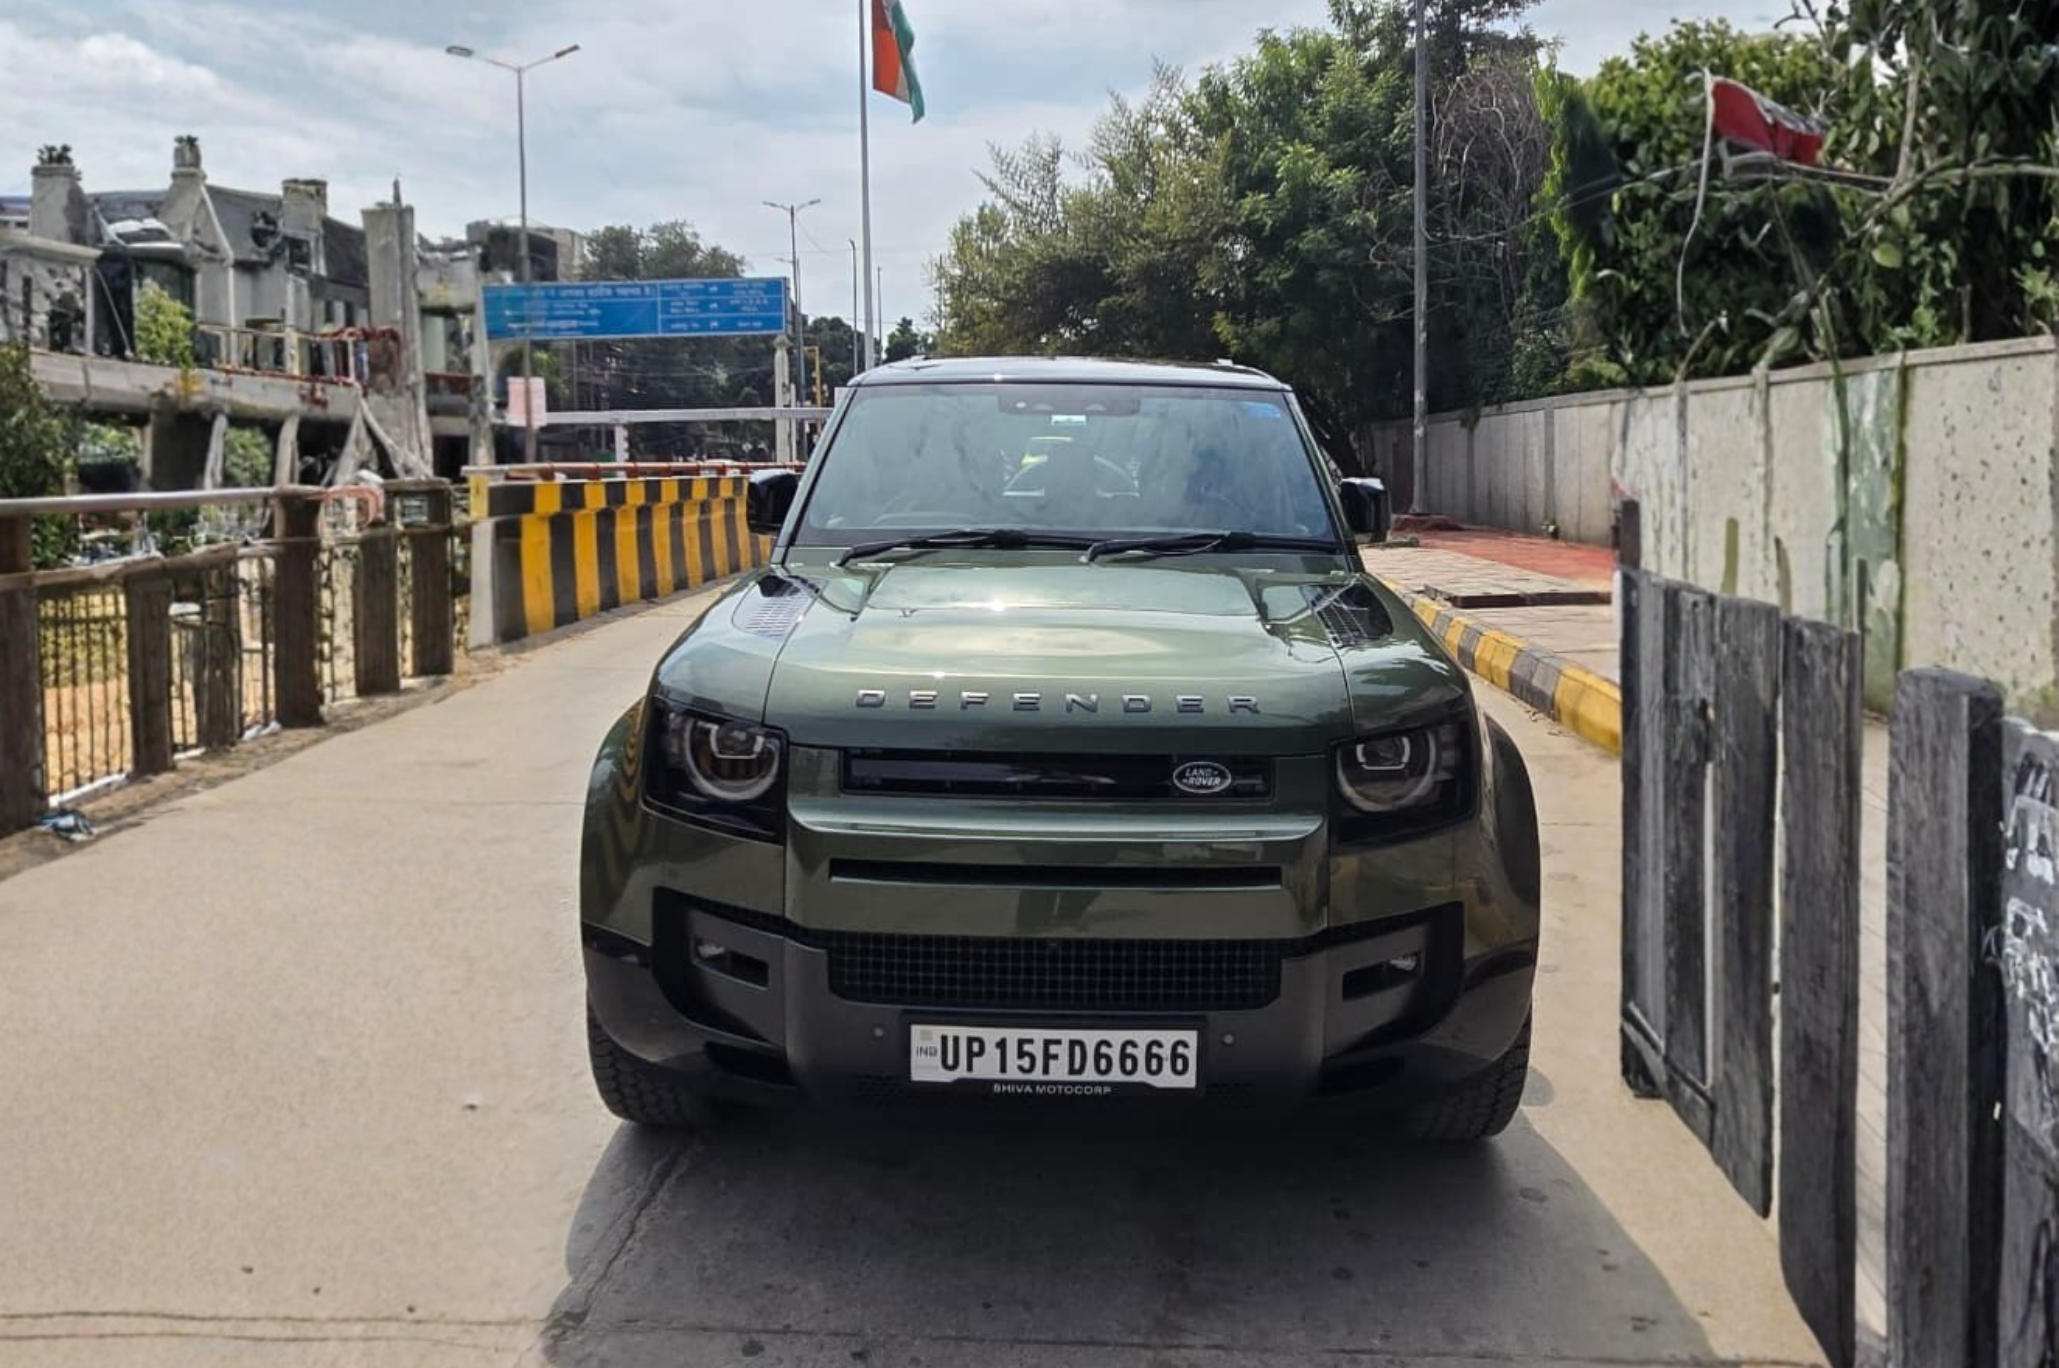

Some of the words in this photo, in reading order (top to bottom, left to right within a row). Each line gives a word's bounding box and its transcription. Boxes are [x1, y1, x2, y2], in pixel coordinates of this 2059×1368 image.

[855, 689, 1261, 713] DEFENDER
[940, 1034, 1190, 1077] UP15FD6666
[993, 1083, 1033, 1095] SHIVA
[1036, 1085, 1112, 1096] MOTOCORP
